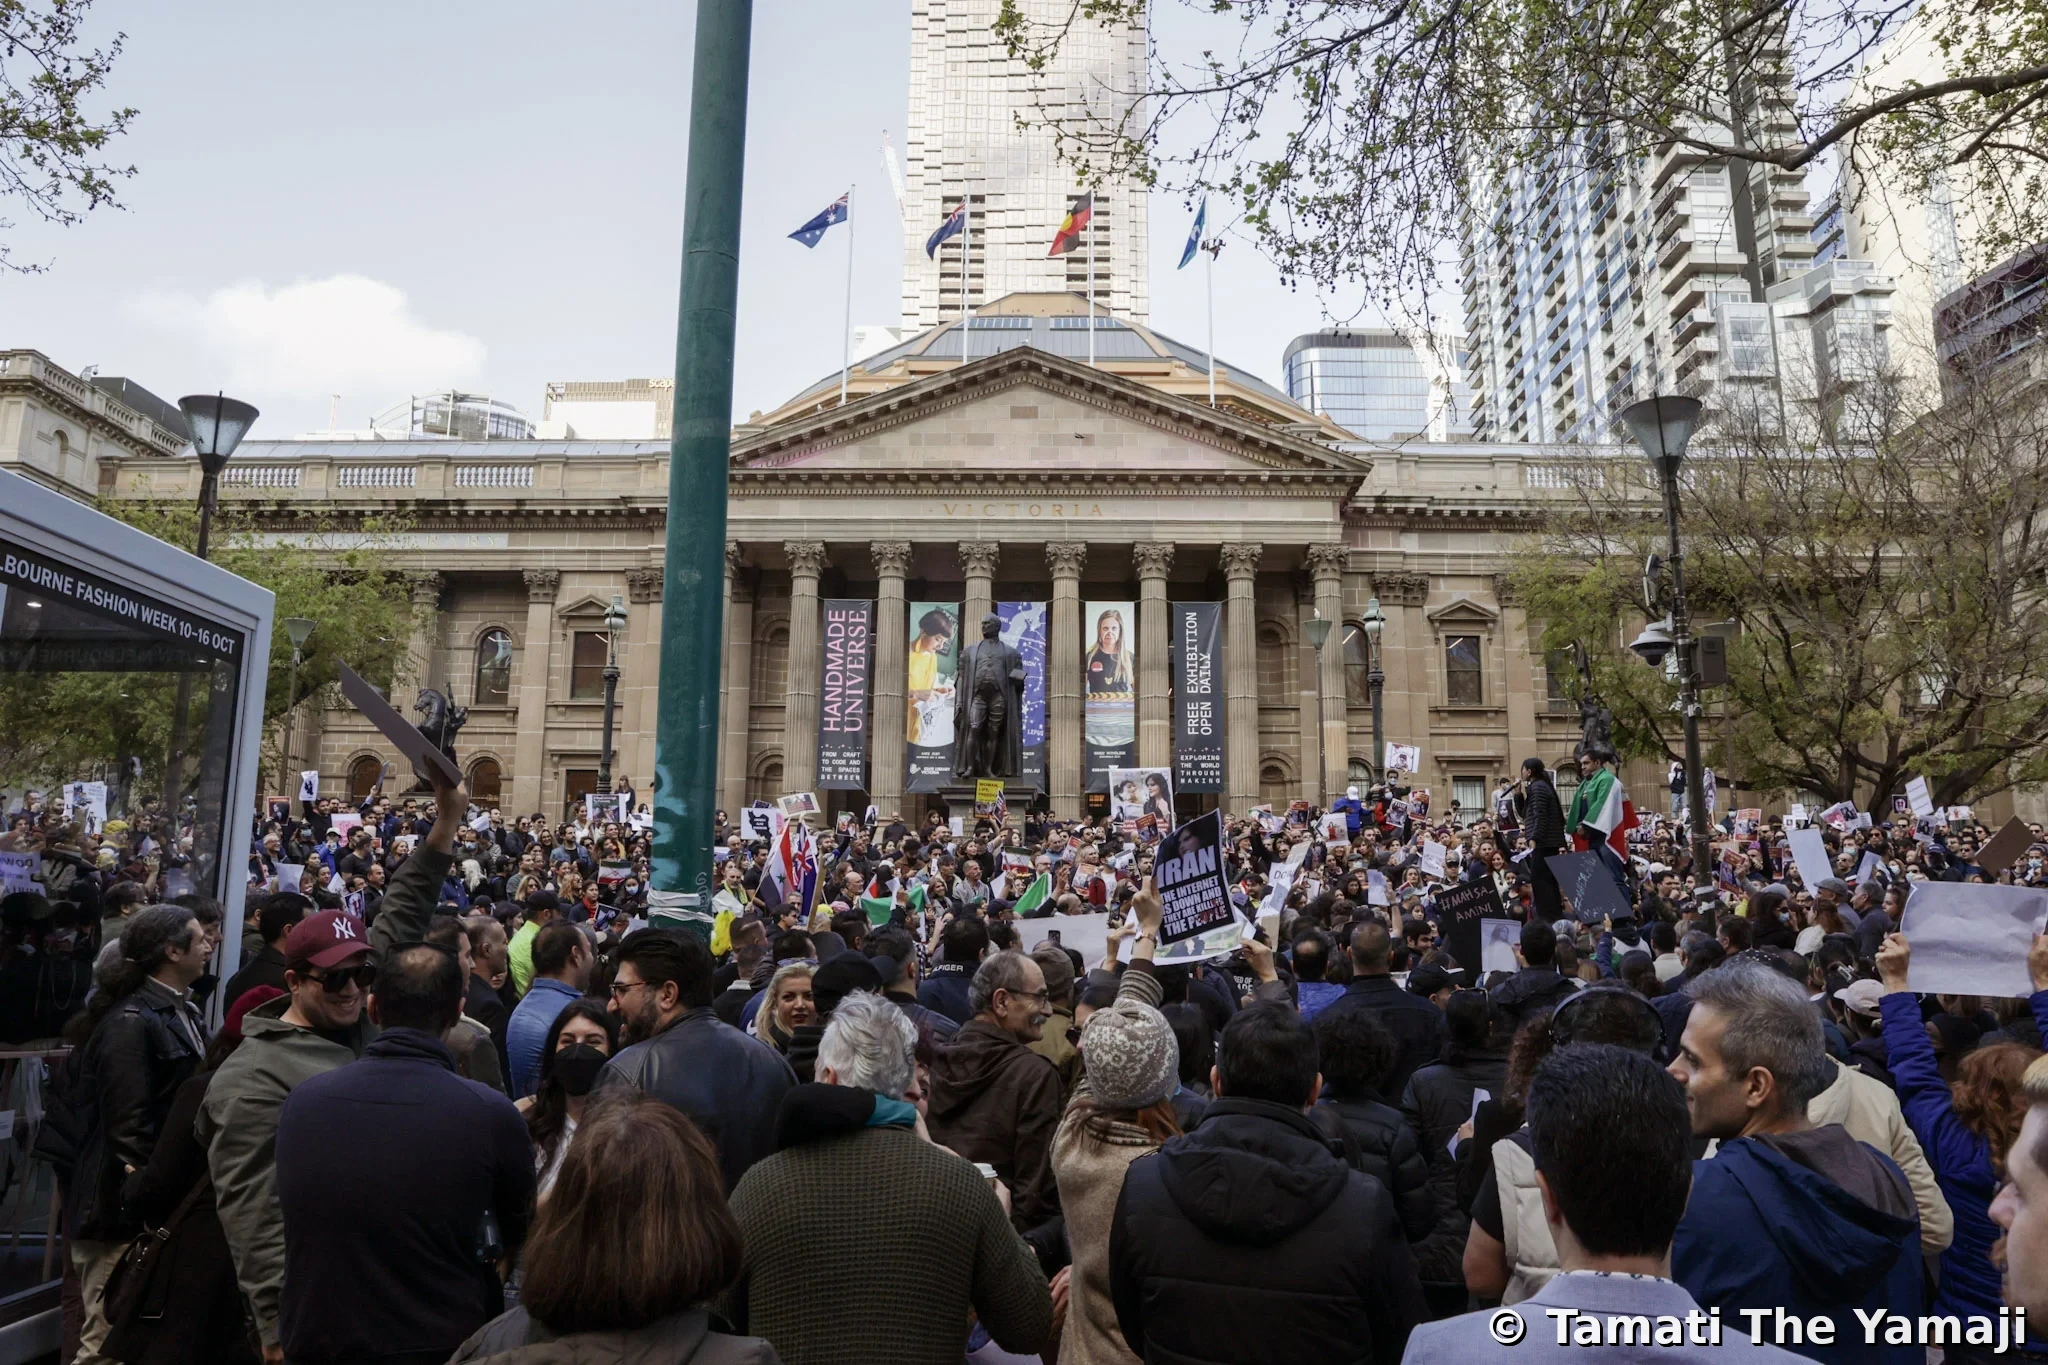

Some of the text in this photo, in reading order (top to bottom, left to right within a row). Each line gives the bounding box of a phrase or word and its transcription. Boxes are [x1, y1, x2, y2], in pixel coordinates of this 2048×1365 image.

[943, 503, 1103, 517] VICTORIA
[0, 554, 73, 595] BOURNE
[76, 581, 139, 620] FASHION
[141, 604, 177, 633] WEEK
[212, 633, 236, 655] OCT
[823, 610, 846, 732] HANDMADE
[844, 610, 867, 733] UNIVERSE
[1186, 612, 1199, 736] FREE EXHIBITION
[1199, 653, 1212, 736] OPEN DAILY
[1156, 845, 1217, 889] IRAN
[1160, 874, 1220, 902] THE INTERNET
[1163, 886, 1223, 916] IS DOWN AND
[1163, 897, 1225, 924] THEY ARE KILLING
[1164, 905, 1228, 937] THE PEOPLE
[1456, 902, 1494, 923] AMINI
[332, 917, 356, 940] NY
